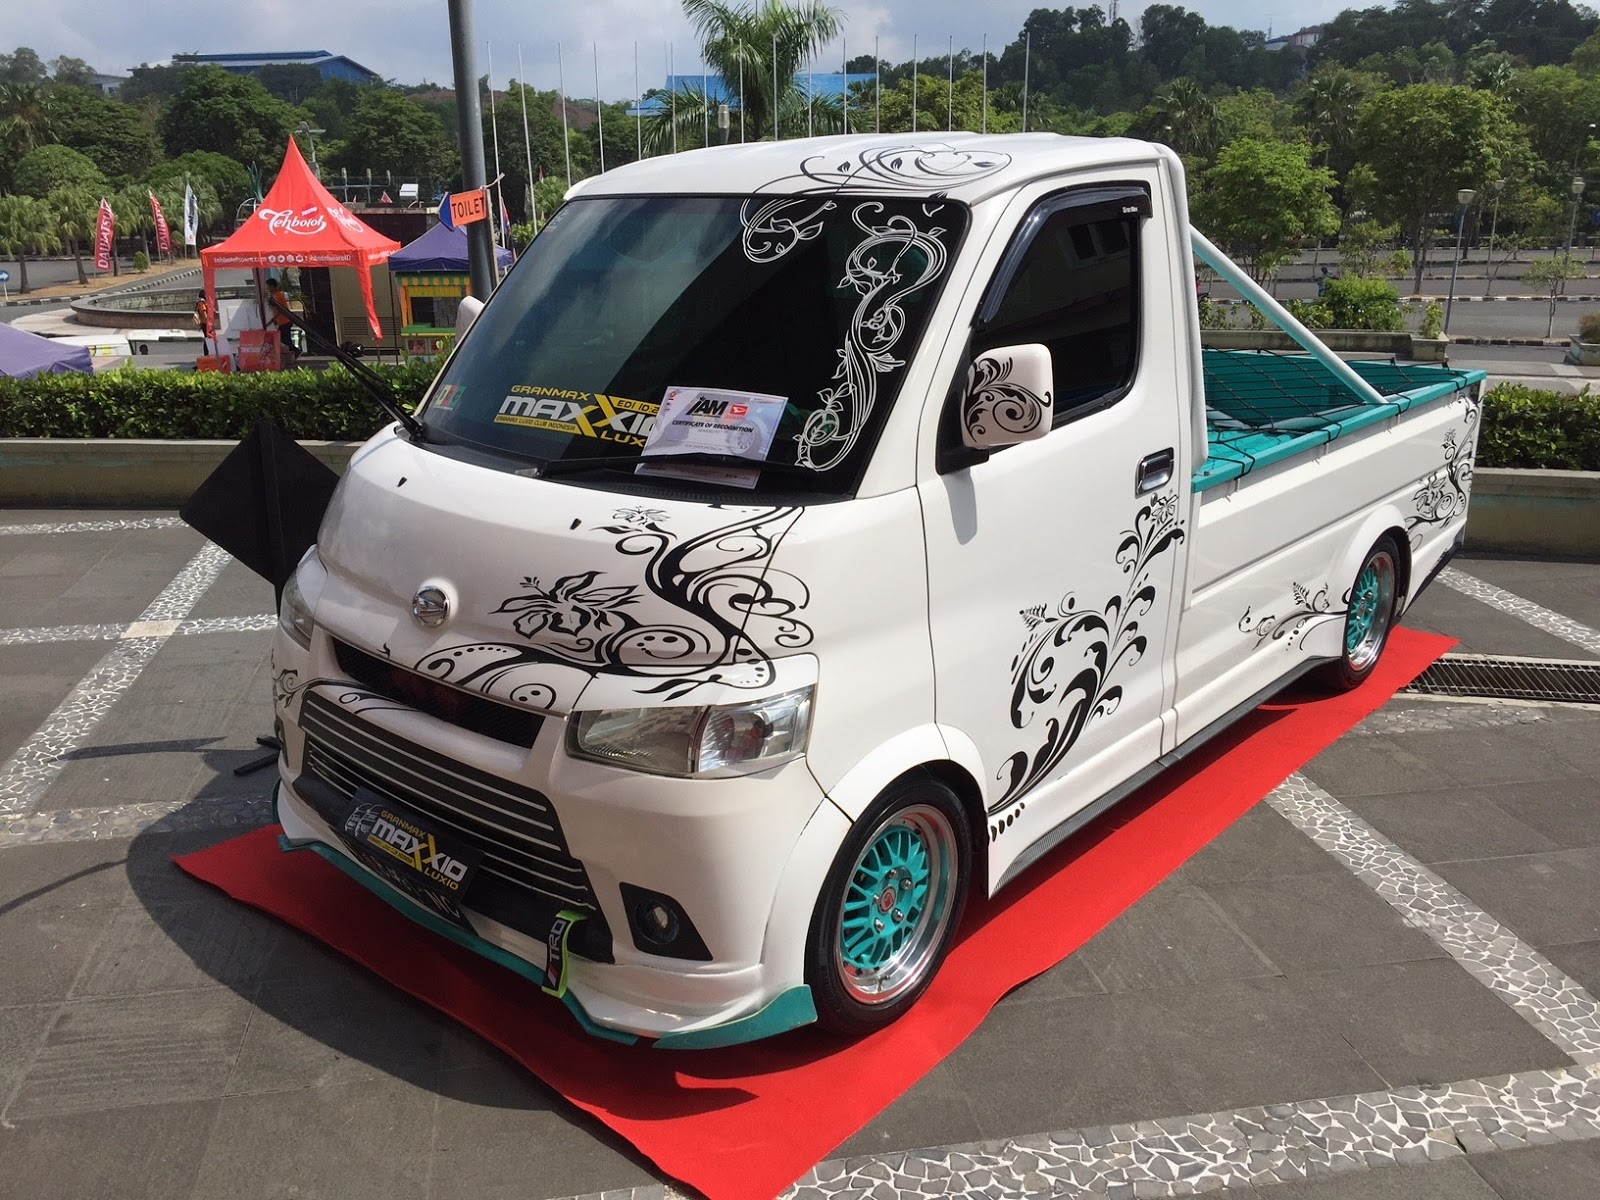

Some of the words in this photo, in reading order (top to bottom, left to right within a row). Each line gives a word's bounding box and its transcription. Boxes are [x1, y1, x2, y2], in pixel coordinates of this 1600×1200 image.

[452, 196, 485, 219] TOILET
[258, 208, 327, 235] Tehbotol
[98, 204, 112, 269] DAIHATSU
[511, 385, 591, 401] GRANMAX
[617, 400, 636, 409] EDI
[534, 419, 548, 427] CLUB
[548, 421, 577, 431] INDONESIA
[672, 420, 704, 429] CERTIFICATE
[713, 424, 755, 433] RECOGNITION
[380, 809, 427, 839] GRANMAX
[371, 817, 469, 883] MAXXIO
[424, 867, 459, 891] LUXIO
[549, 920, 567, 962] TRD
